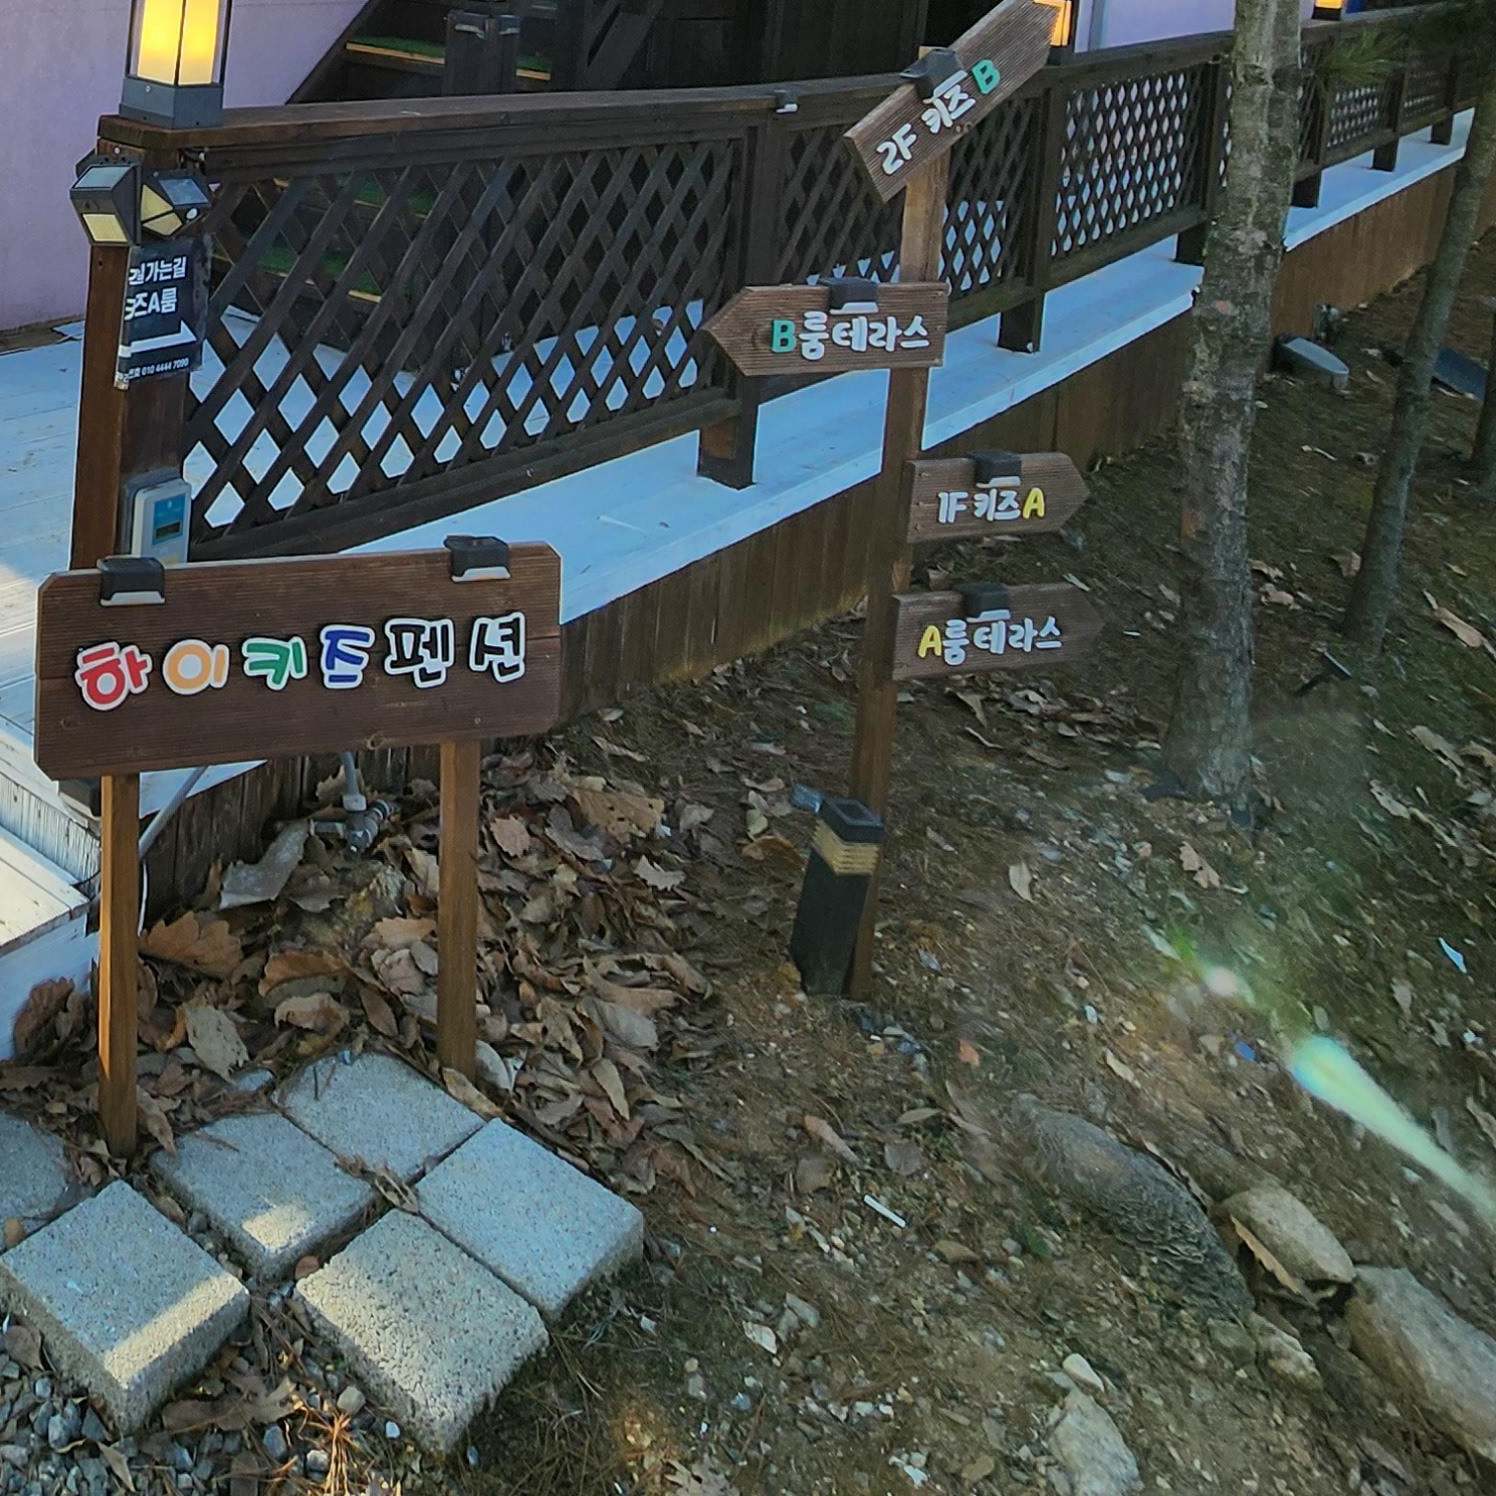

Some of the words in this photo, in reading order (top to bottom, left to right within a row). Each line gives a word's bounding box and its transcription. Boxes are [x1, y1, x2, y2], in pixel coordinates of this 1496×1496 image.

[876, 123, 917, 175] 2F
[771, 311, 931, 361] B룸테라스
[938, 491, 969, 524] 1F
[74, 612, 526, 711] 하이키즈펜션
[918, 615, 1063, 666] A룸테라스
